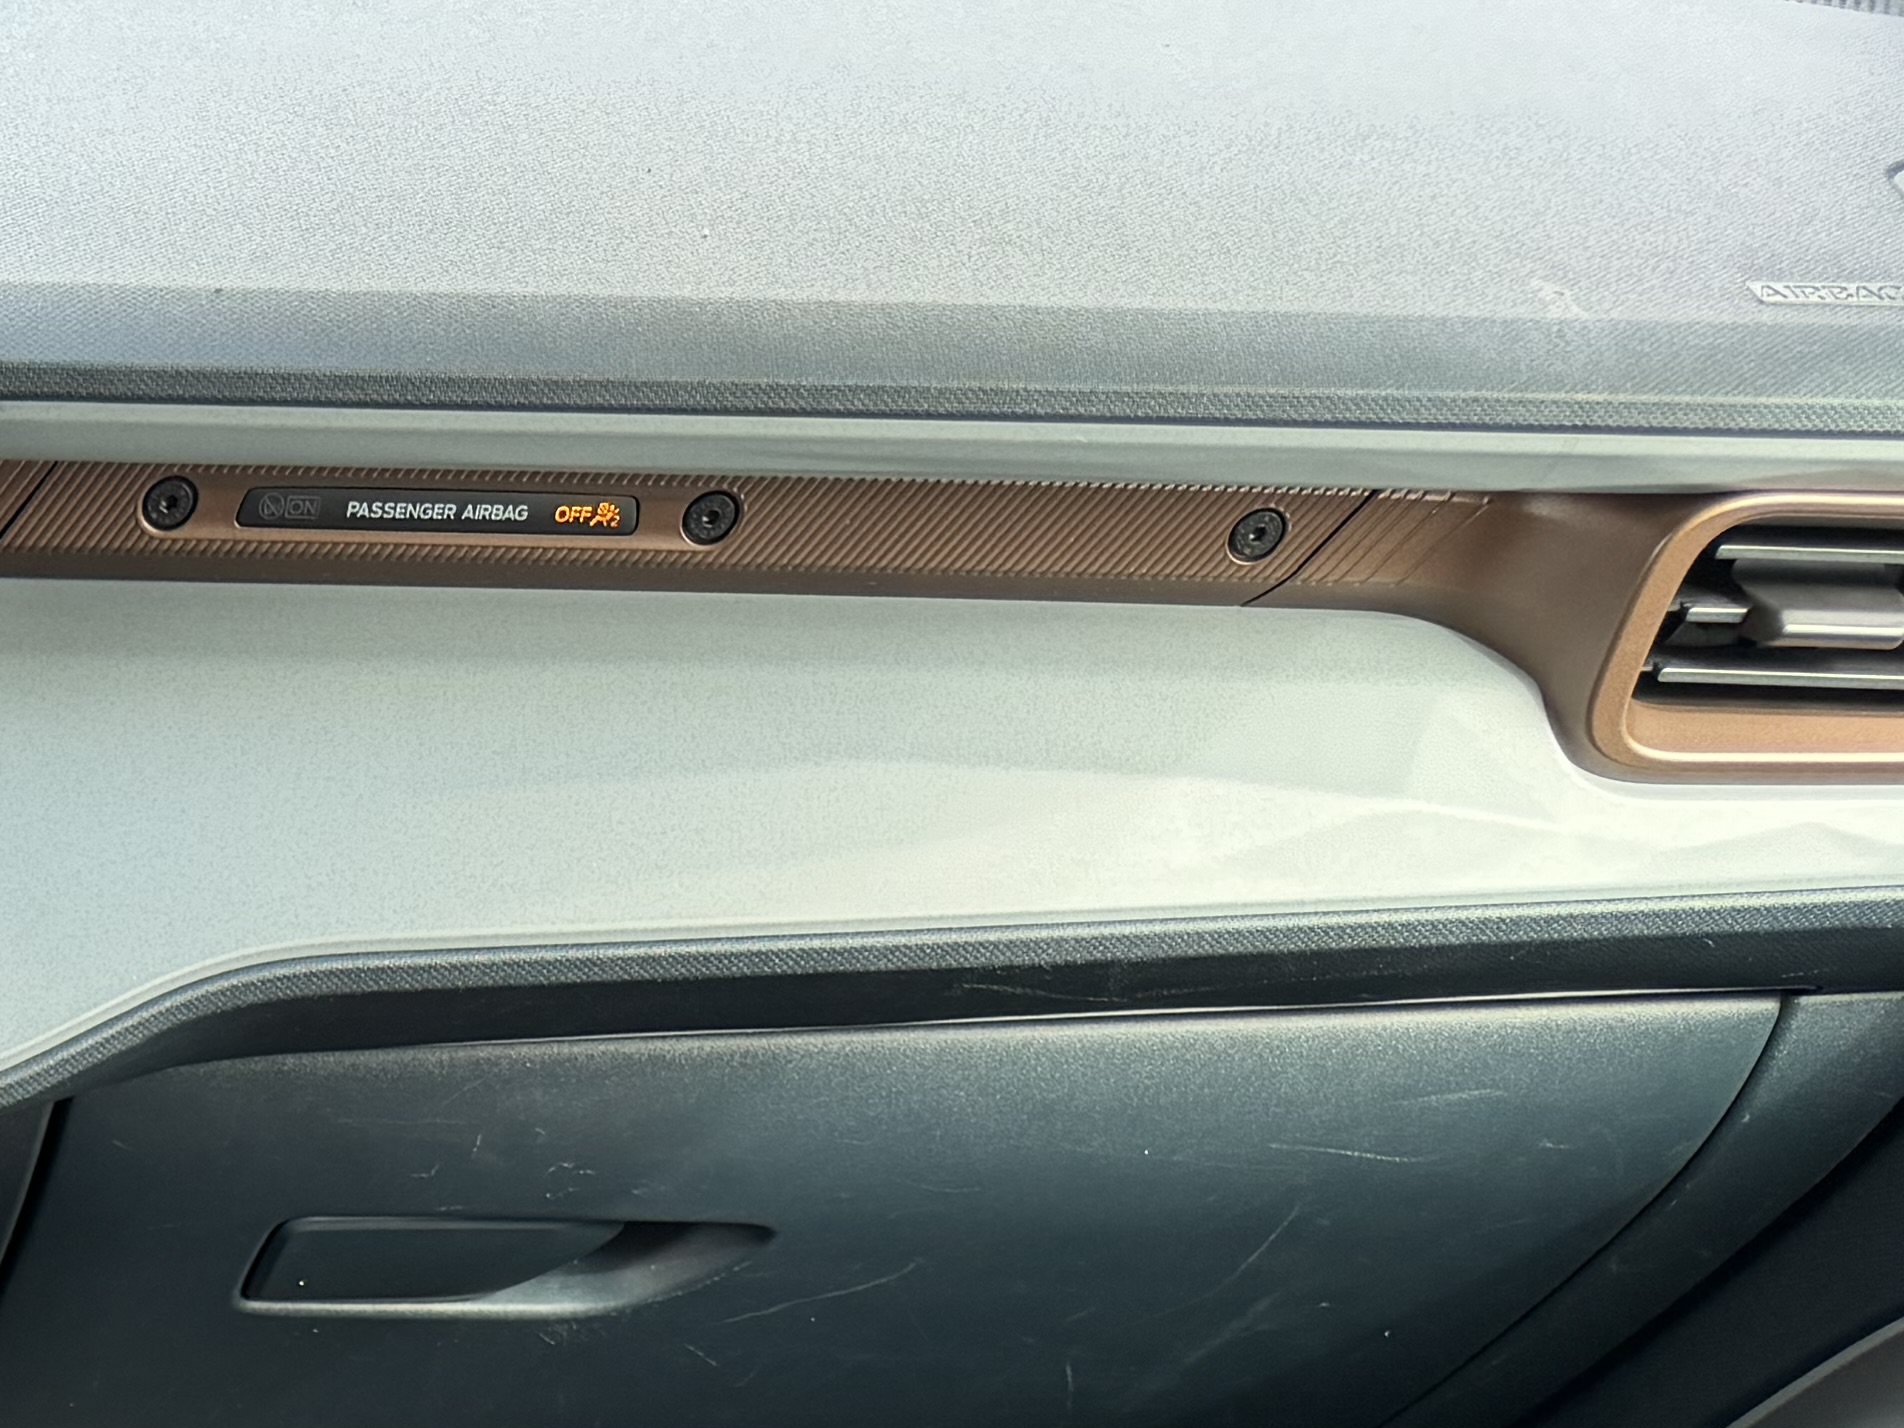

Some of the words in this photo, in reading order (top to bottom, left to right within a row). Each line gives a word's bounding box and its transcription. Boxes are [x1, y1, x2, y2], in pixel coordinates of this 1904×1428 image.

[346, 501, 456, 520] PASSENGER
[460, 503, 529, 522] AIRBAG
[554, 505, 592, 523] OFF
